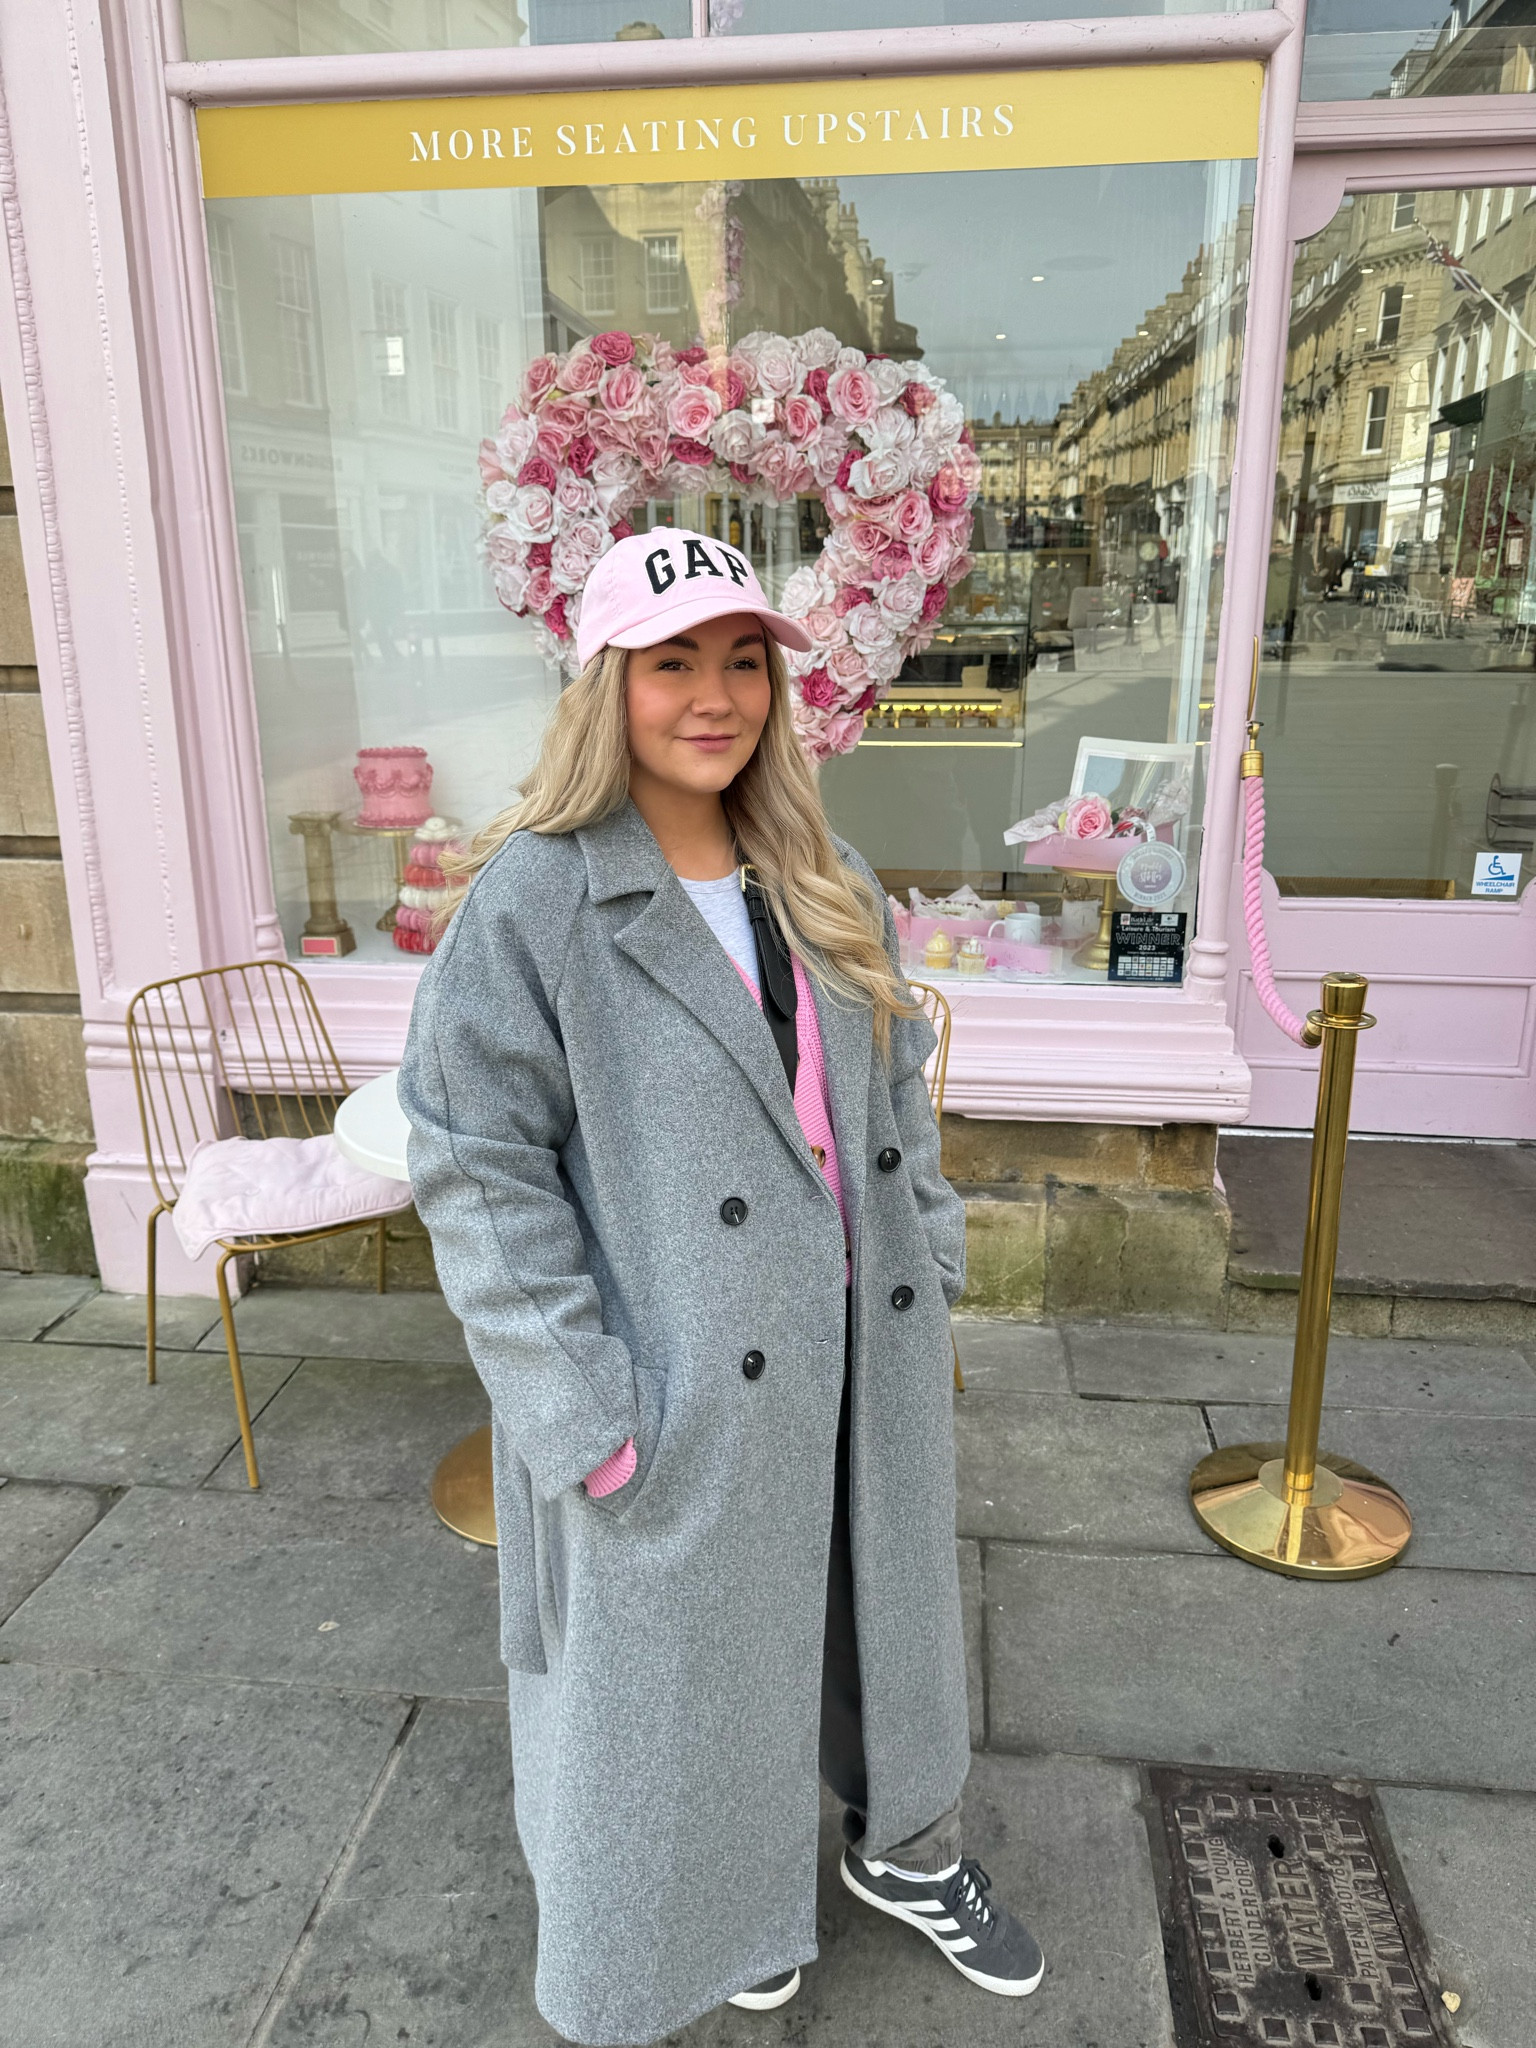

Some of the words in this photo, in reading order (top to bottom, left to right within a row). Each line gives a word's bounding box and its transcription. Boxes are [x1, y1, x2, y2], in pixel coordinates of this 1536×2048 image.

[409, 126, 534, 162] MORE
[556, 115, 758, 156] SEATING
[782, 103, 1017, 147] UPSTAIRS
[644, 539, 749, 595] GAP
[1115, 932, 1181, 945] WINNER
[1208, 1837, 1233, 1886] YOUNG
[1220, 1890, 1237, 1901] &
[1232, 1858, 1273, 1964] CINDERFORD
[1273, 1859, 1333, 1967] WATER
[1221, 1908, 1256, 1986] HERBERT
